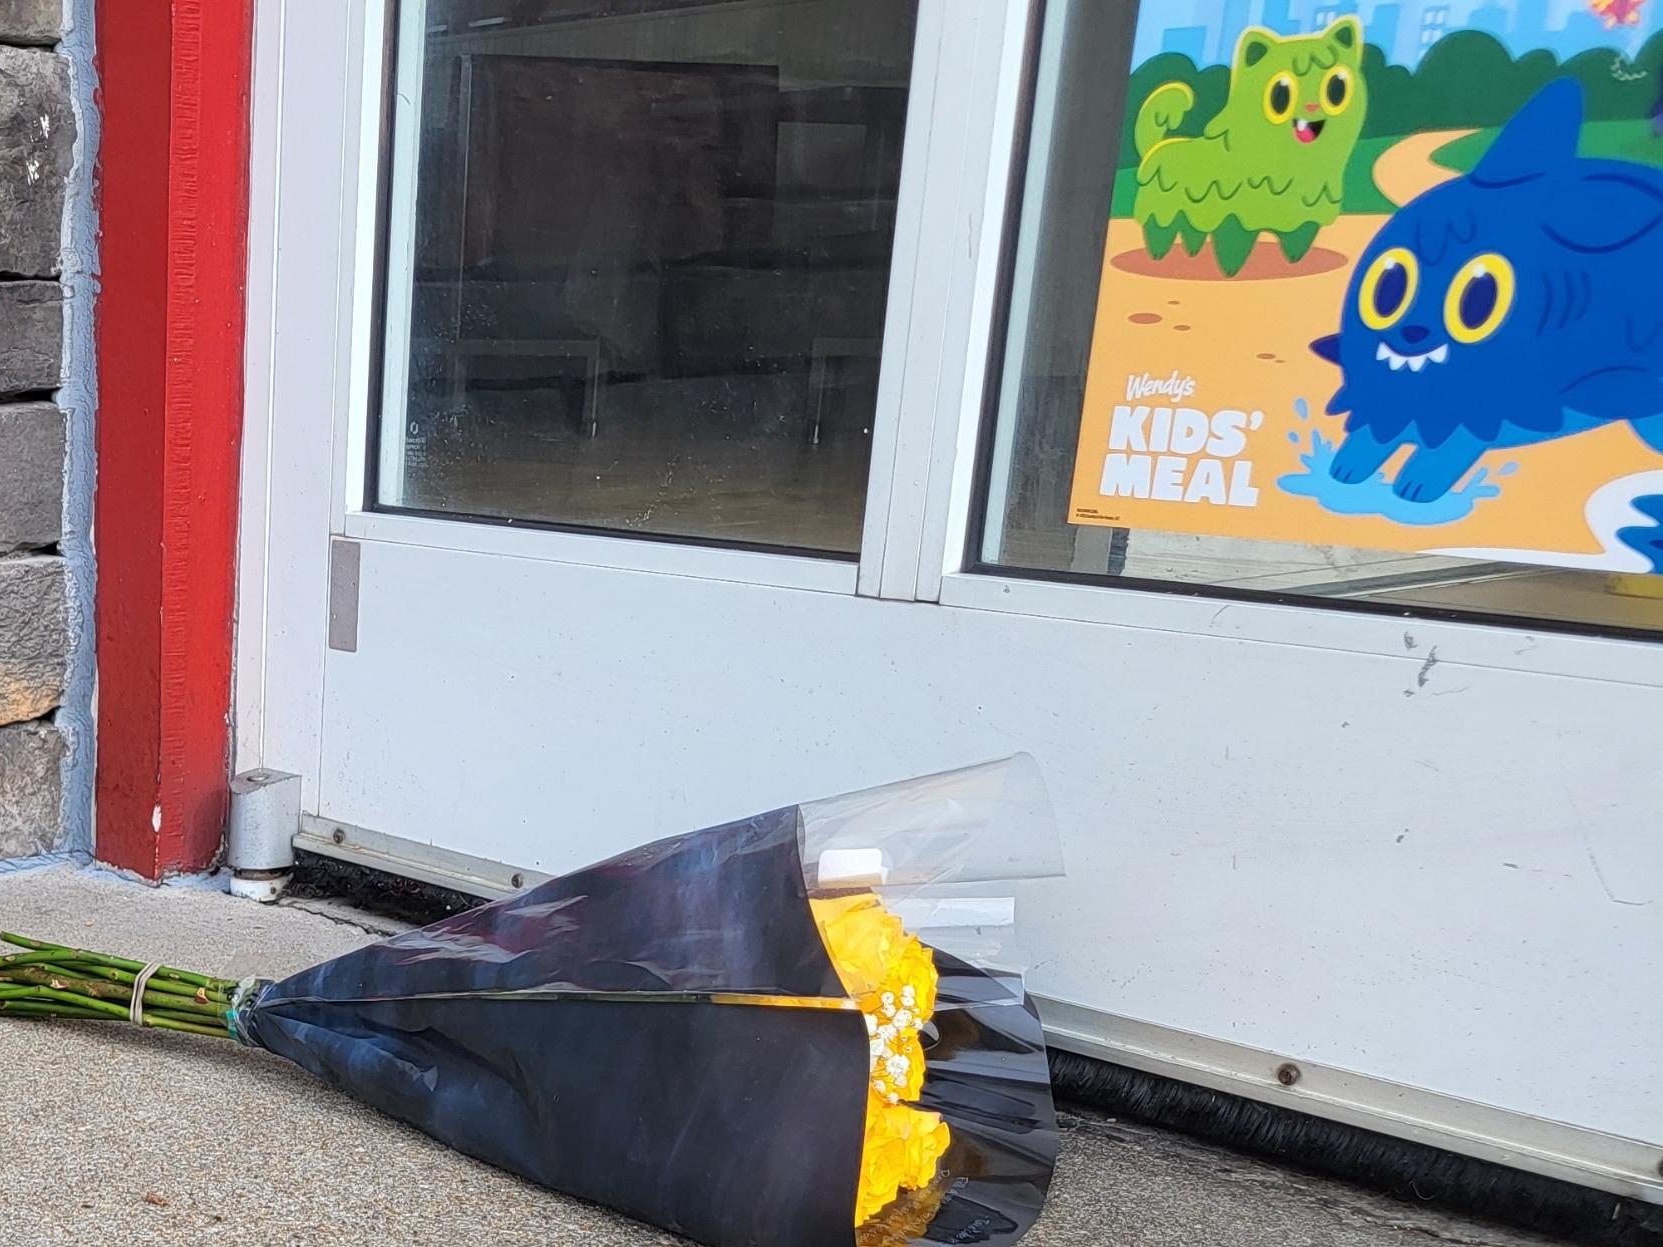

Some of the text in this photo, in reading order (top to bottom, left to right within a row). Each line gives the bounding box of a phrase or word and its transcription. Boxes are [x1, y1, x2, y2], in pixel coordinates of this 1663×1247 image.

[1126, 370, 1195, 403] Wendy's
[1109, 405, 1264, 458] KIDS'
[1099, 453, 1259, 507] MEAL
